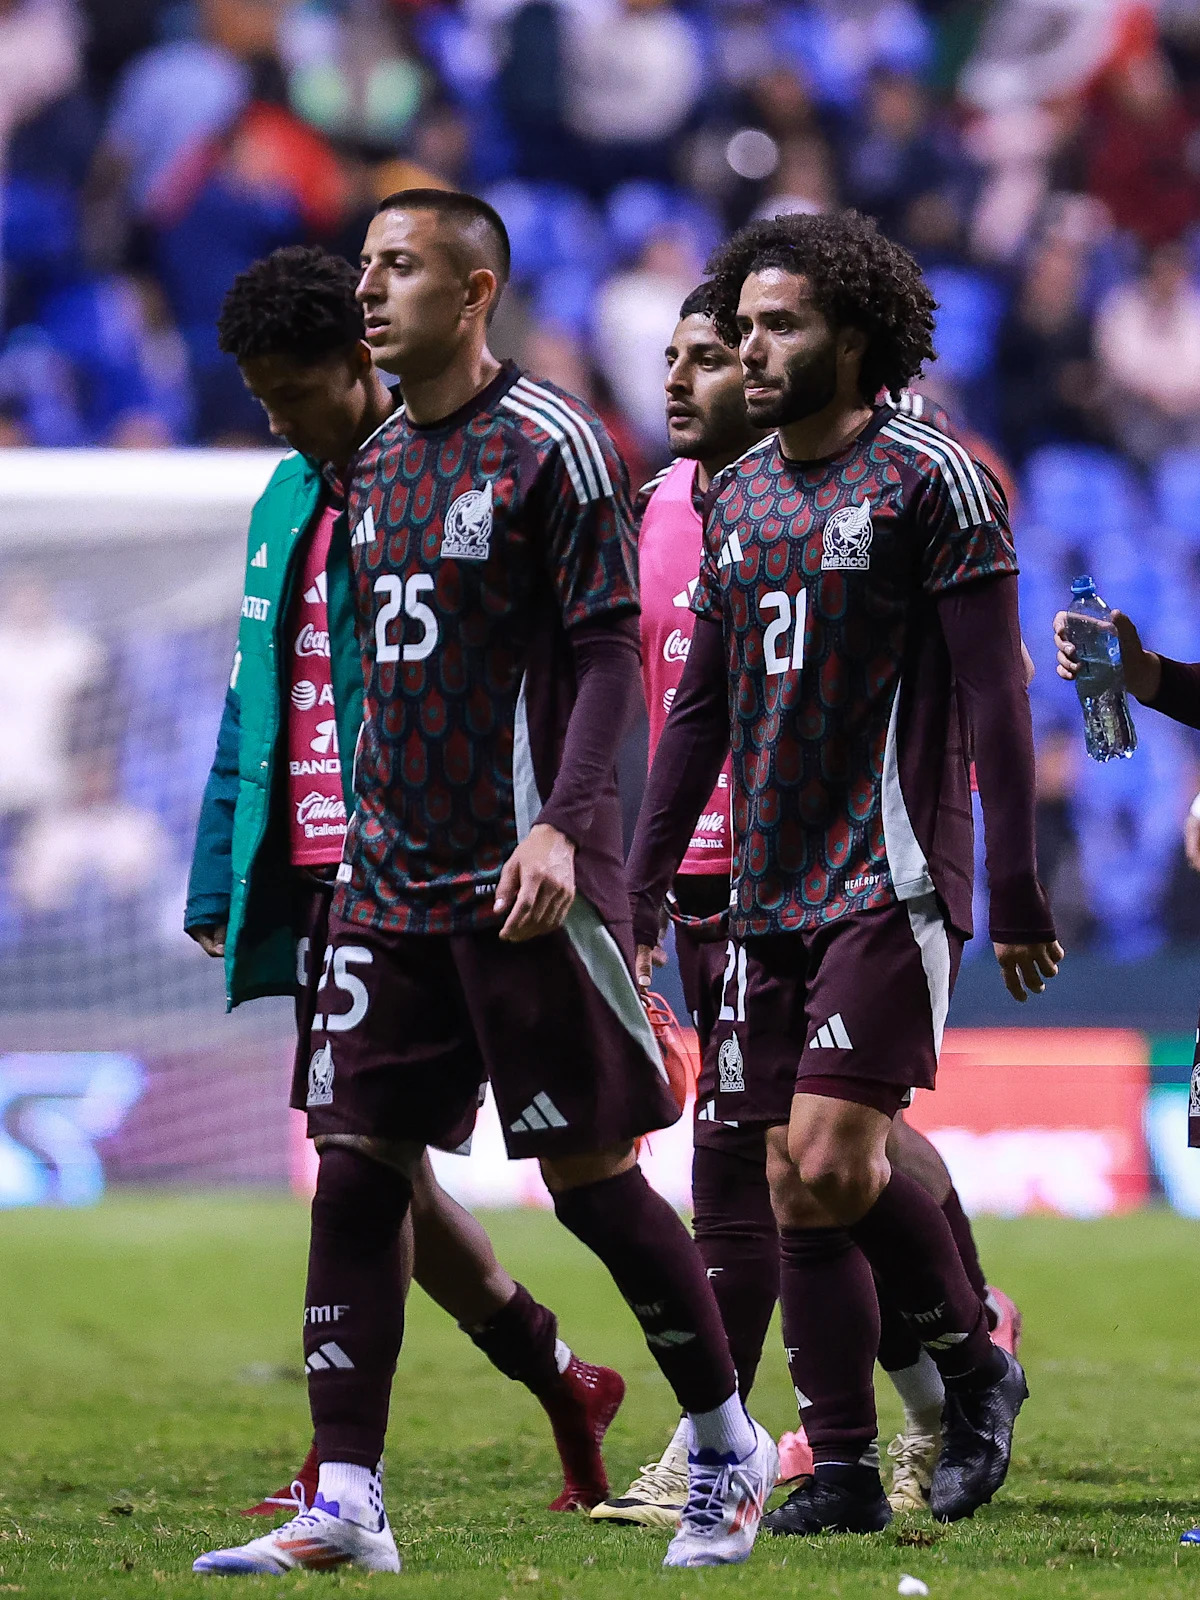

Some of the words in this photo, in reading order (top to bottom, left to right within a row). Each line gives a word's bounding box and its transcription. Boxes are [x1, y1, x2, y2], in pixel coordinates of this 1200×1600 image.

[823, 555, 867, 567] MÉXICO
[241, 595, 271, 622] AT&T
[374, 573, 439, 662] 25
[759, 587, 807, 676] 21
[718, 939, 748, 1022] 21
